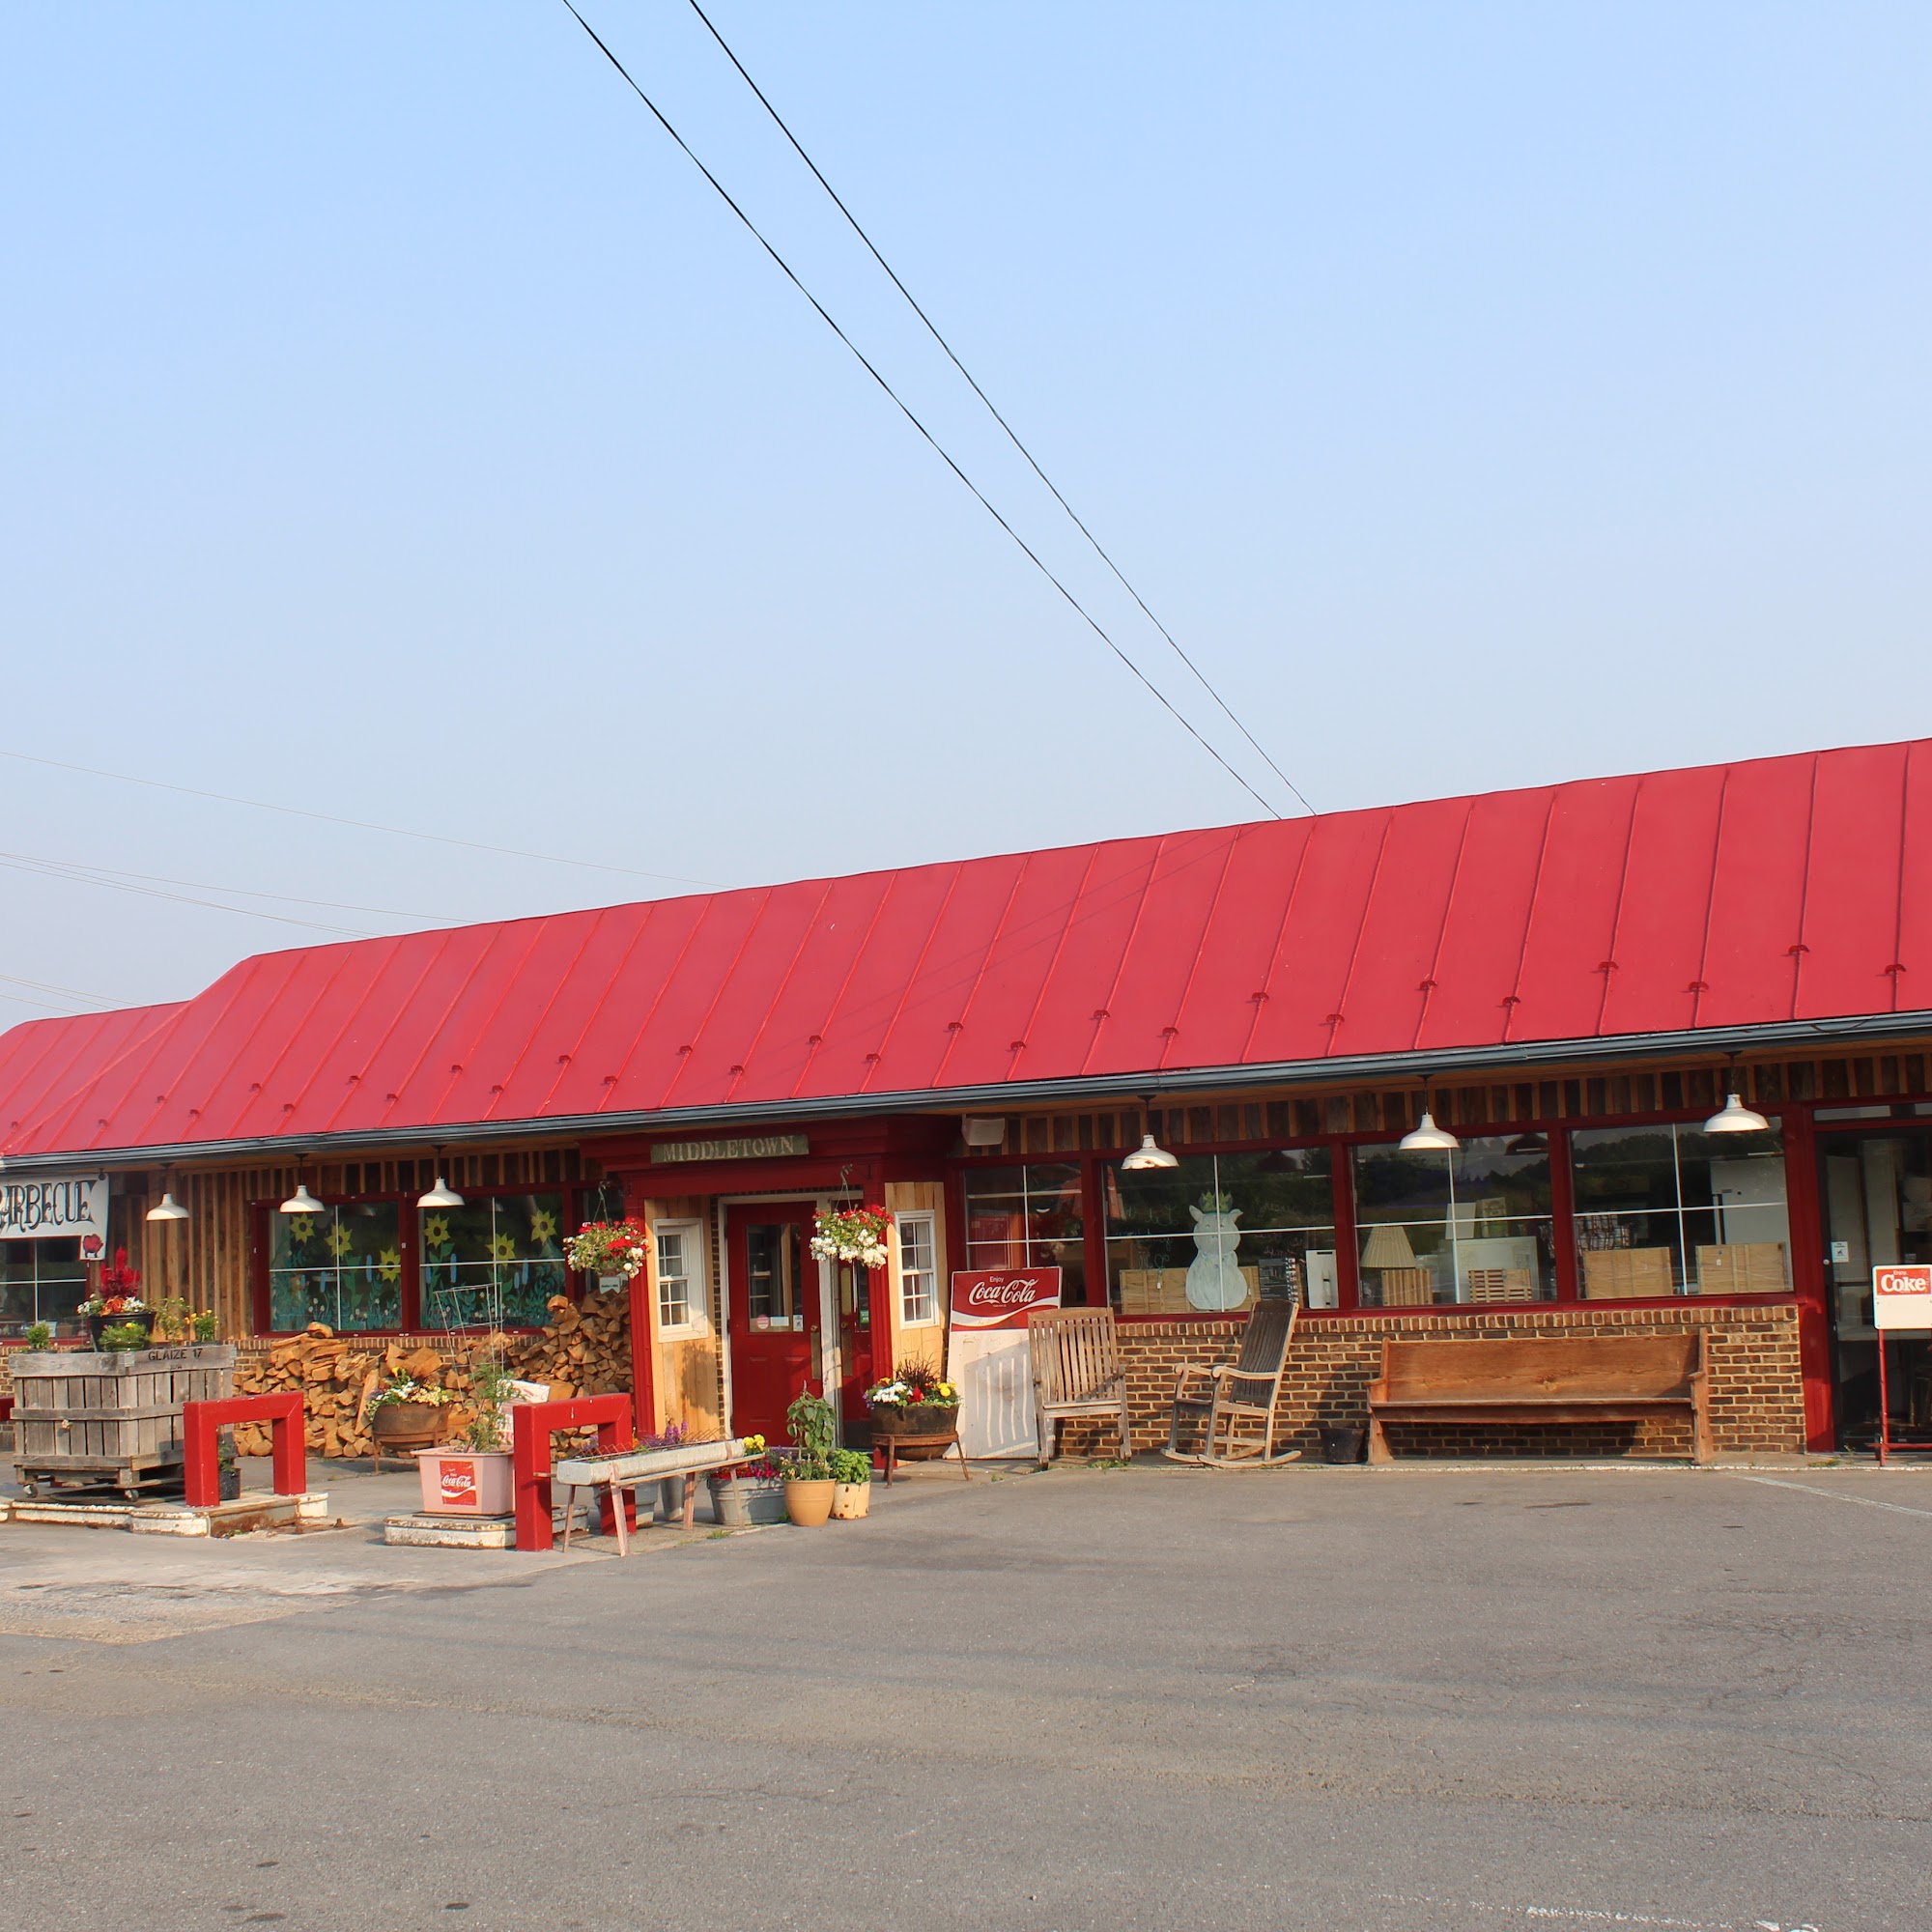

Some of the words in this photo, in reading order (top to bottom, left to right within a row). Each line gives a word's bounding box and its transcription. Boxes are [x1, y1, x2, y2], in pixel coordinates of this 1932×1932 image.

[663, 1135, 794, 1162] MIDDLETOWN
[0, 1179, 98, 1233] ARBECUE
[969, 1278, 1039, 1306] Coca-Cola
[1880, 1273, 1927, 1293] Coke
[148, 1349, 187, 1361] GLAIZE
[193, 1348, 203, 1359] 17
[442, 1474, 472, 1488] Coca-Cola
